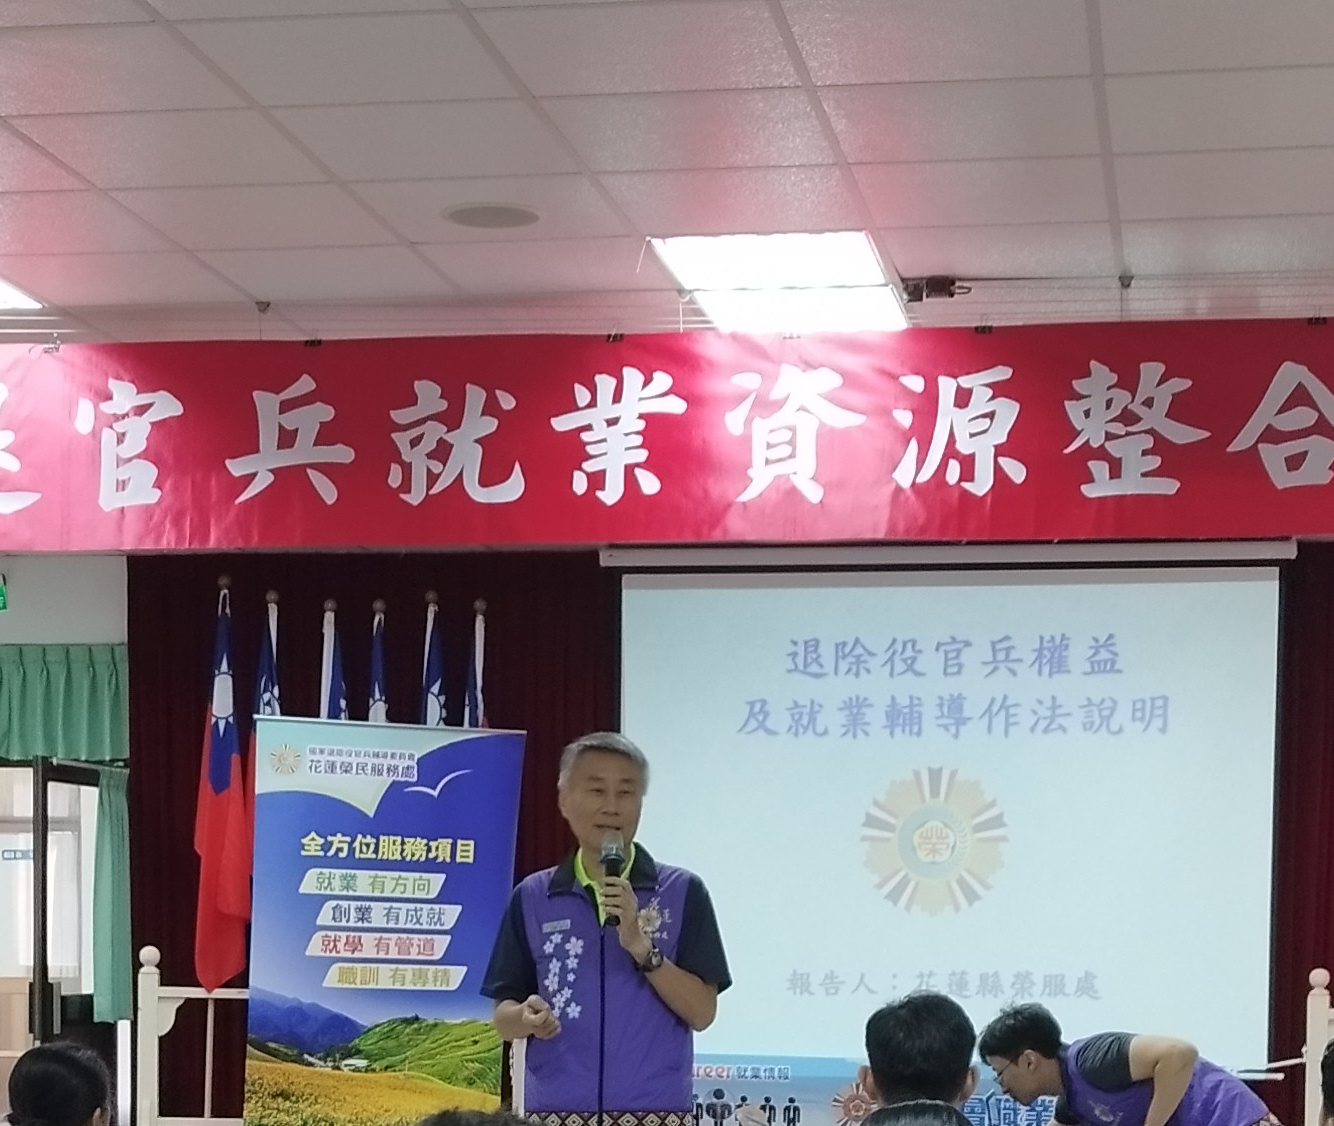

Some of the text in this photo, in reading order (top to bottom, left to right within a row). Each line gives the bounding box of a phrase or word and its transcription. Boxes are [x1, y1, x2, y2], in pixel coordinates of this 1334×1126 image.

[785, 634, 1124, 679] 退除役官兵權益
[308, 759, 416, 779] 花蓮榮民服務處
[300, 831, 475, 863] 全方位服務項目
[316, 871, 431, 895] 就業 有方向
[331, 903, 445, 926] 創業 有成就
[321, 934, 435, 956] 就學 有管道
[338, 966, 451, 987] 職訓 有專精
